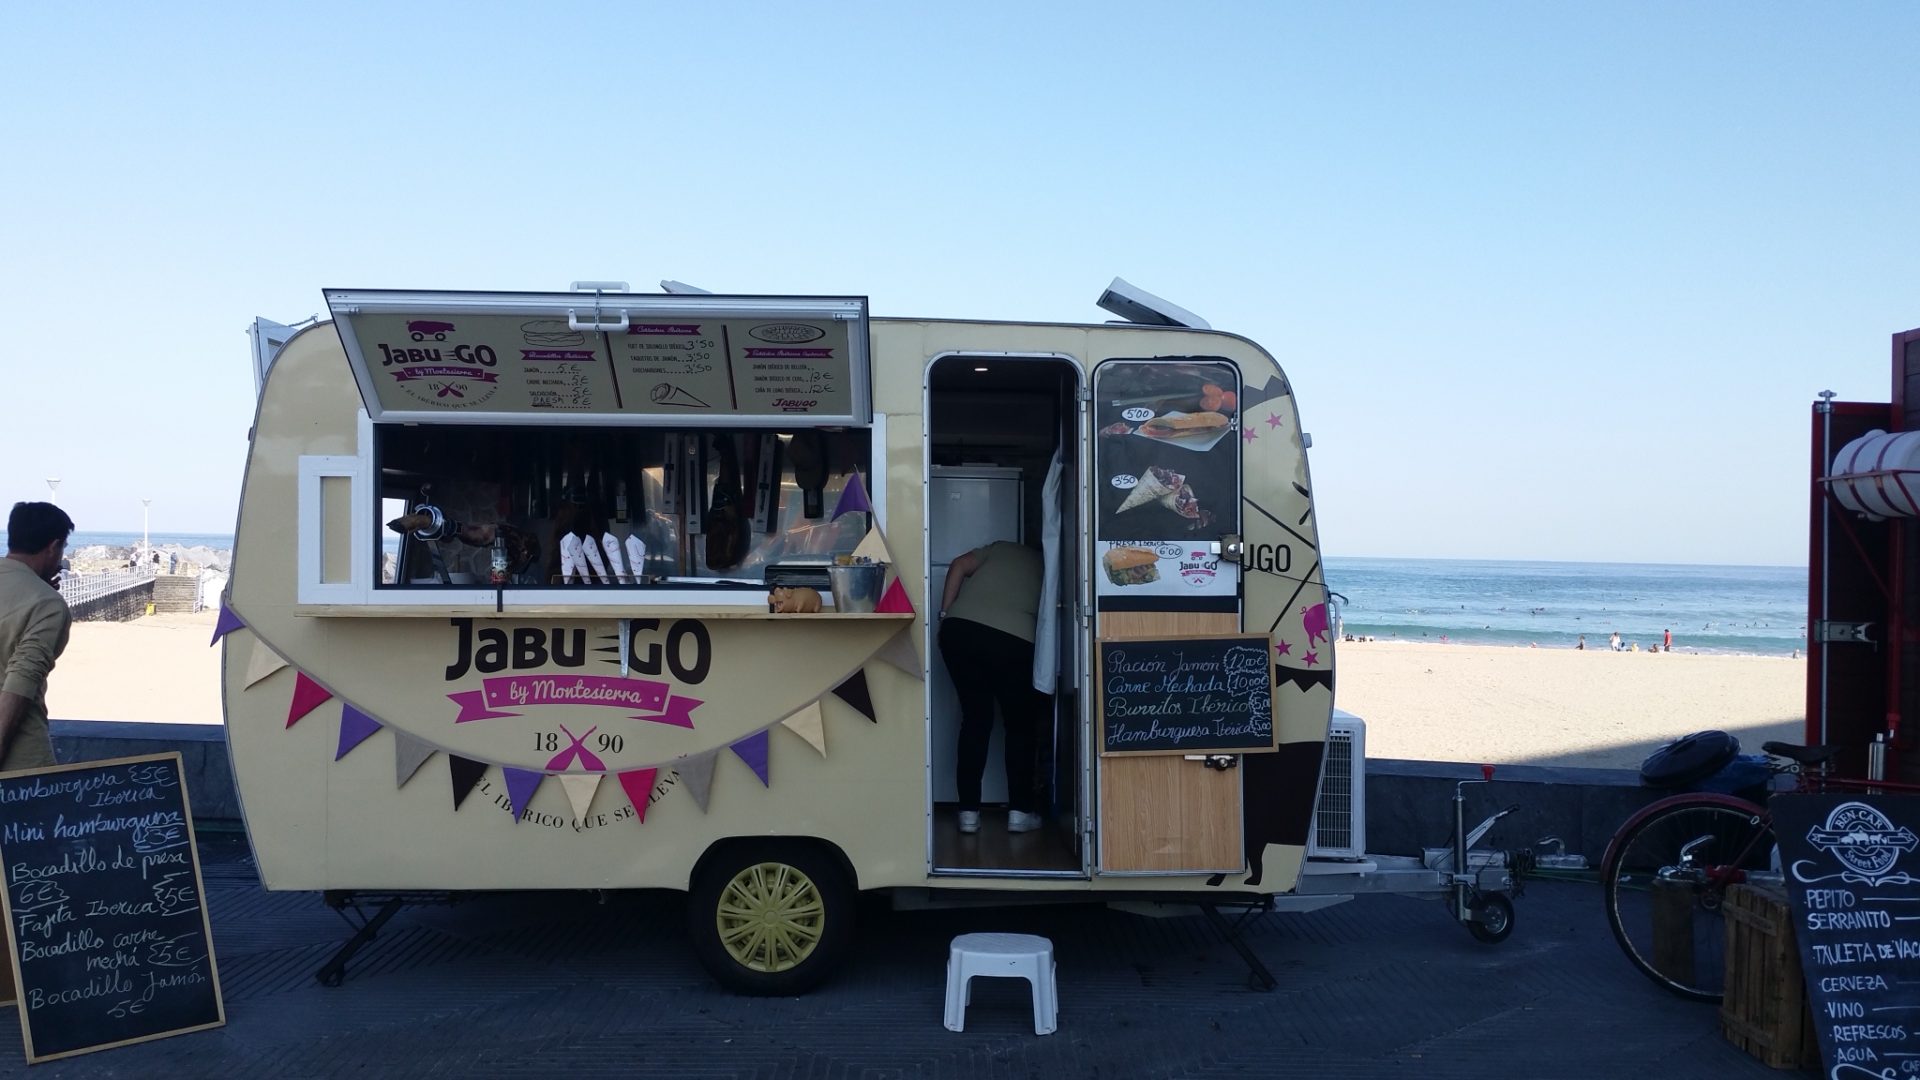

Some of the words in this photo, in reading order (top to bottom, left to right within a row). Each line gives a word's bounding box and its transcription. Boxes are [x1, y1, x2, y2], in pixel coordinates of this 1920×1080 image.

[628, 618, 712, 685] GO
[510, 681, 529, 704] by
[532, 679, 642, 703] Montesierra
[1107, 676, 1151, 695] Carne
[1155, 674, 1227, 694] Mechada
[534, 732, 558, 752] 18
[598, 733, 624, 753] 90
[494, 794, 564, 829] IBRICO
[4, 822, 46, 845] Mini
[12, 846, 107, 883] Bocadillo
[112, 845, 138, 869] de
[142, 851, 189, 880] presa
[1844, 849, 1873, 869] Street
[1870, 848, 1892, 869] Food
[1806, 889, 1856, 909] PEPITO
[1807, 910, 1891, 930] SERRANITO
[21, 927, 105, 962] Bocadillo
[113, 929, 166, 949] carne
[1876, 943, 1896, 959] DE
[1894, 938, 1920, 960] VAC
[29, 969, 133, 1010] Bocadillo
[1821, 974, 1889, 993] CERVEZA
[106, 999, 145, 1018] 5€
[1827, 1001, 1865, 1019] VINO
[1833, 1024, 1907, 1043] REFRESCOS
[1837, 1046, 1879, 1065] AGUA
